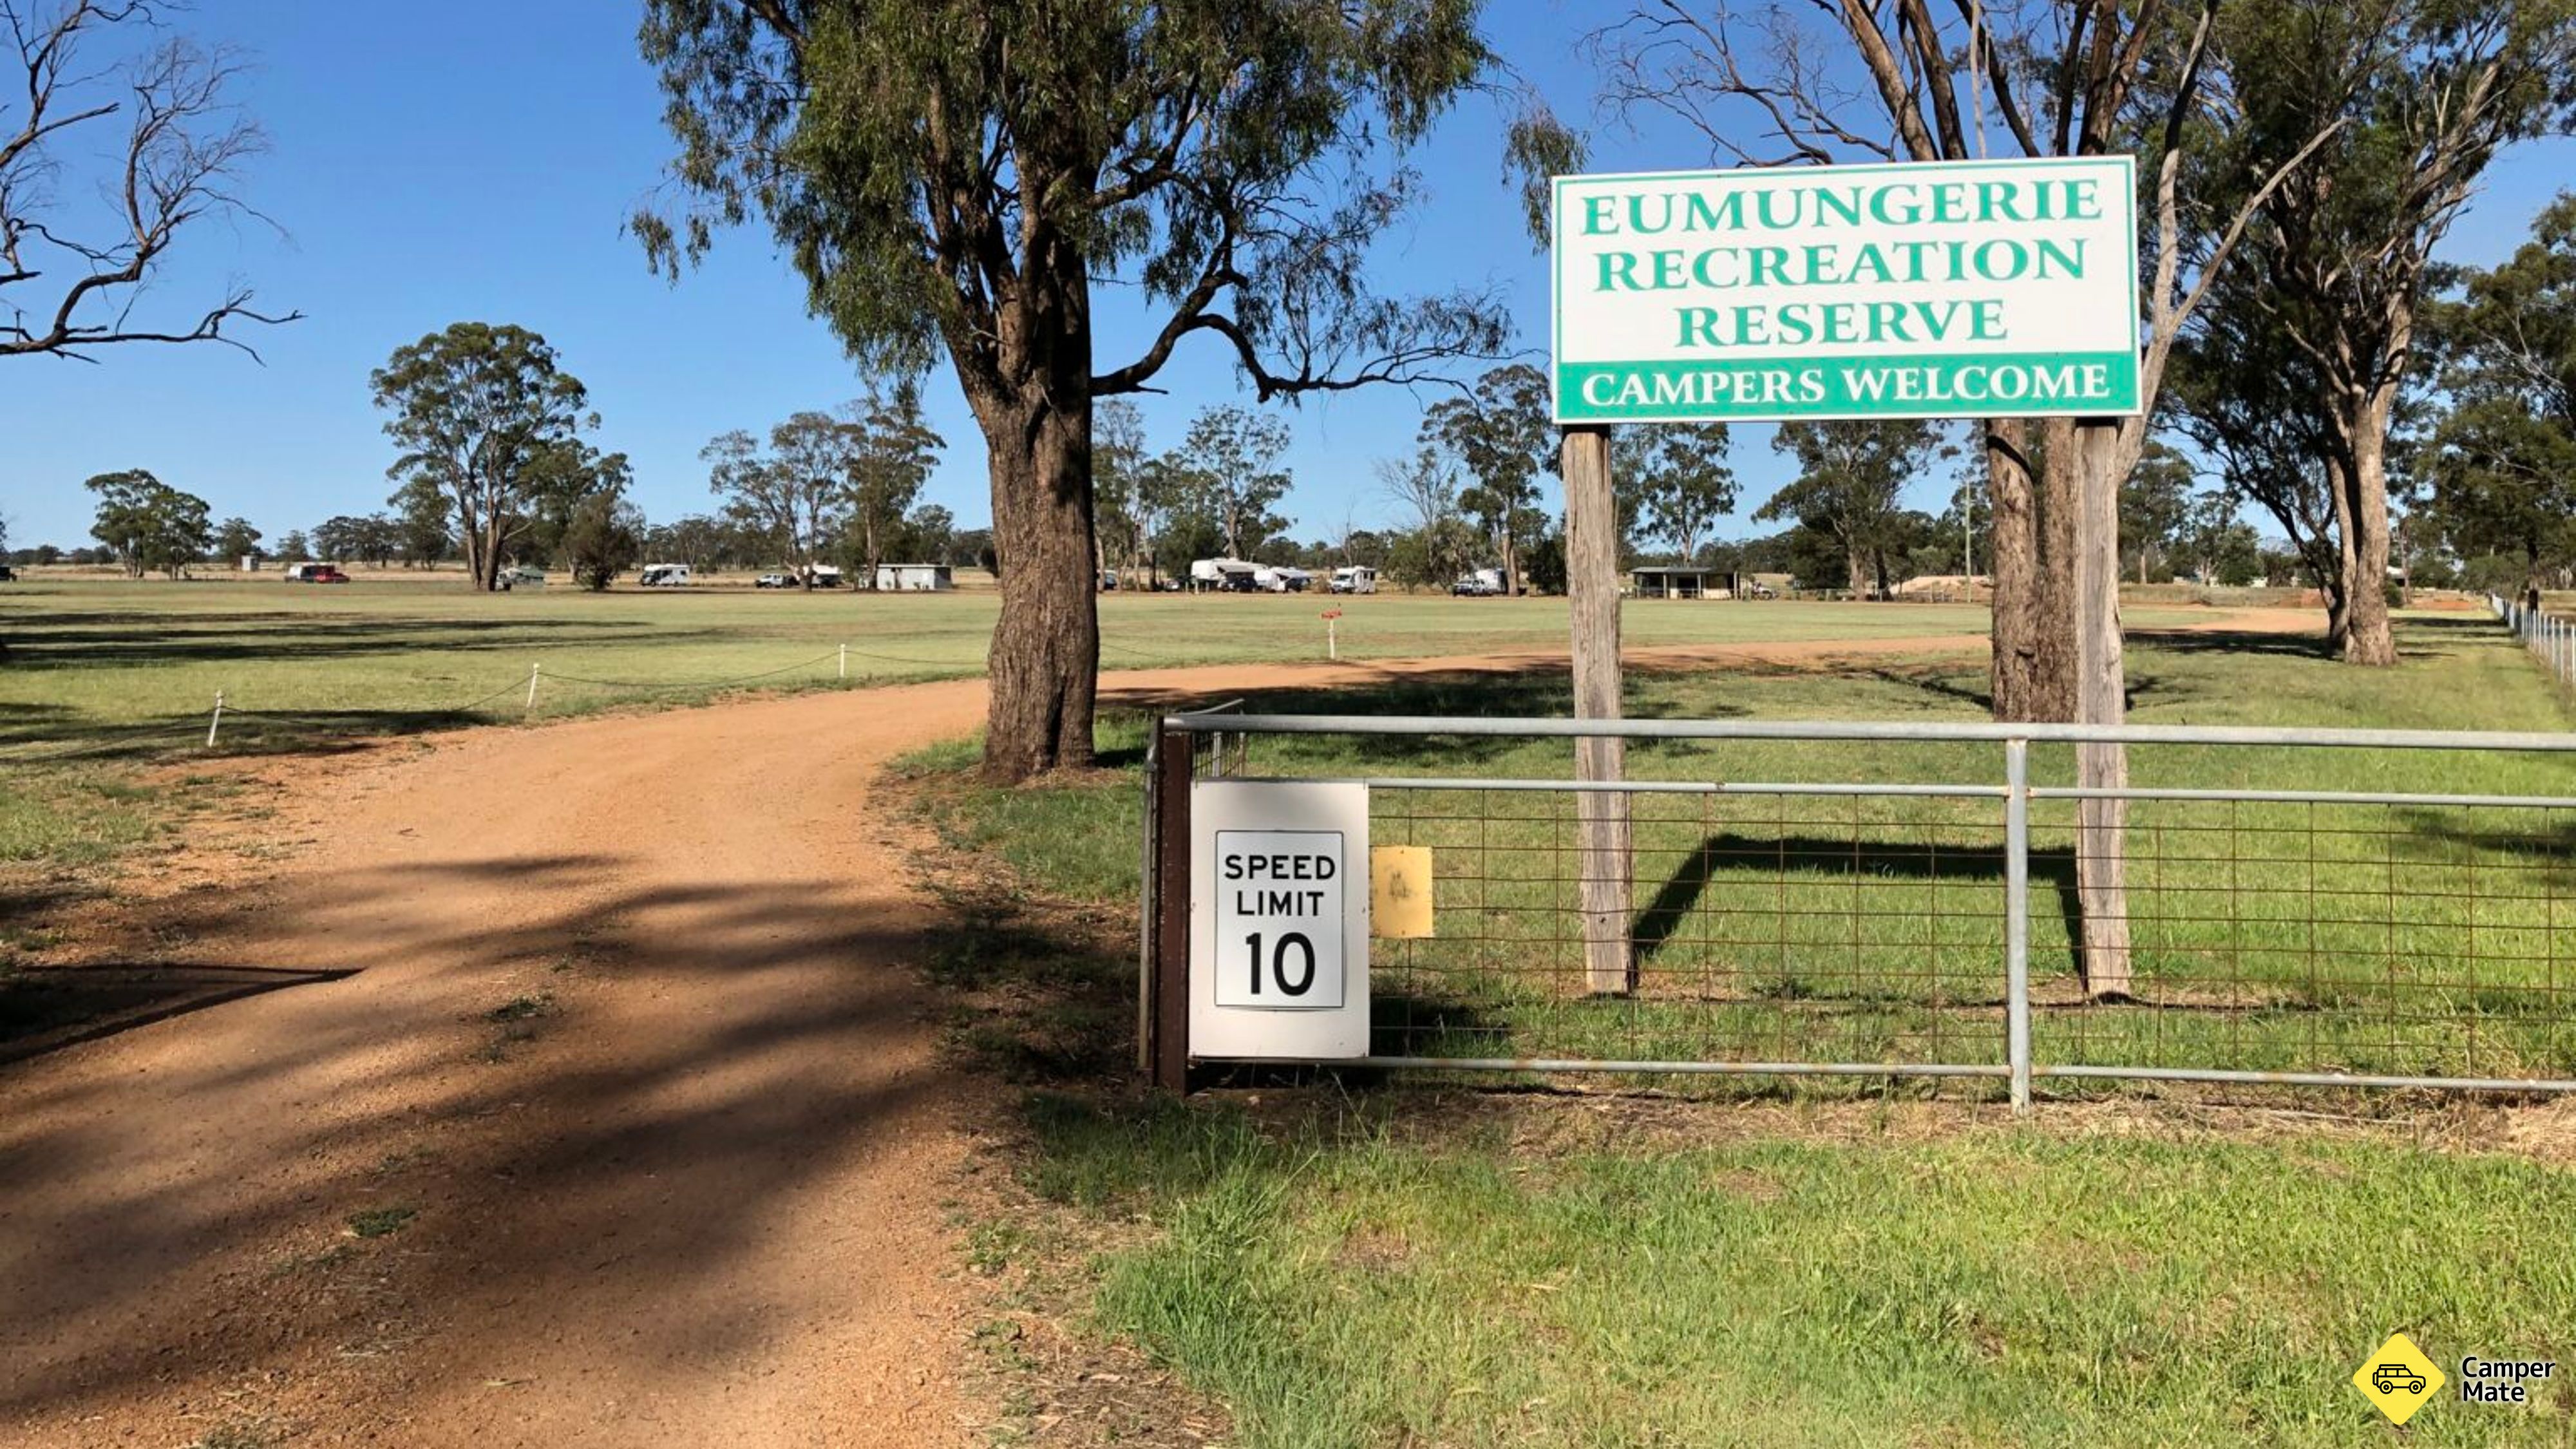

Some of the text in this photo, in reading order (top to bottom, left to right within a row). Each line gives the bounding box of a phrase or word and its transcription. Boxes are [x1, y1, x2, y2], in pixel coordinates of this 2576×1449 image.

[1582, 178, 2103, 236] EUMUNGERIE
[1595, 238, 2088, 292] RECREATION
[1674, 298, 2008, 348] RESERVE
[1582, 364, 2110, 407] CAMPERS WELCOME
[1224, 855, 1335, 880] SPEED
[1237, 891, 1324, 916] LIMIT
[1245, 931, 1316, 997] 10
